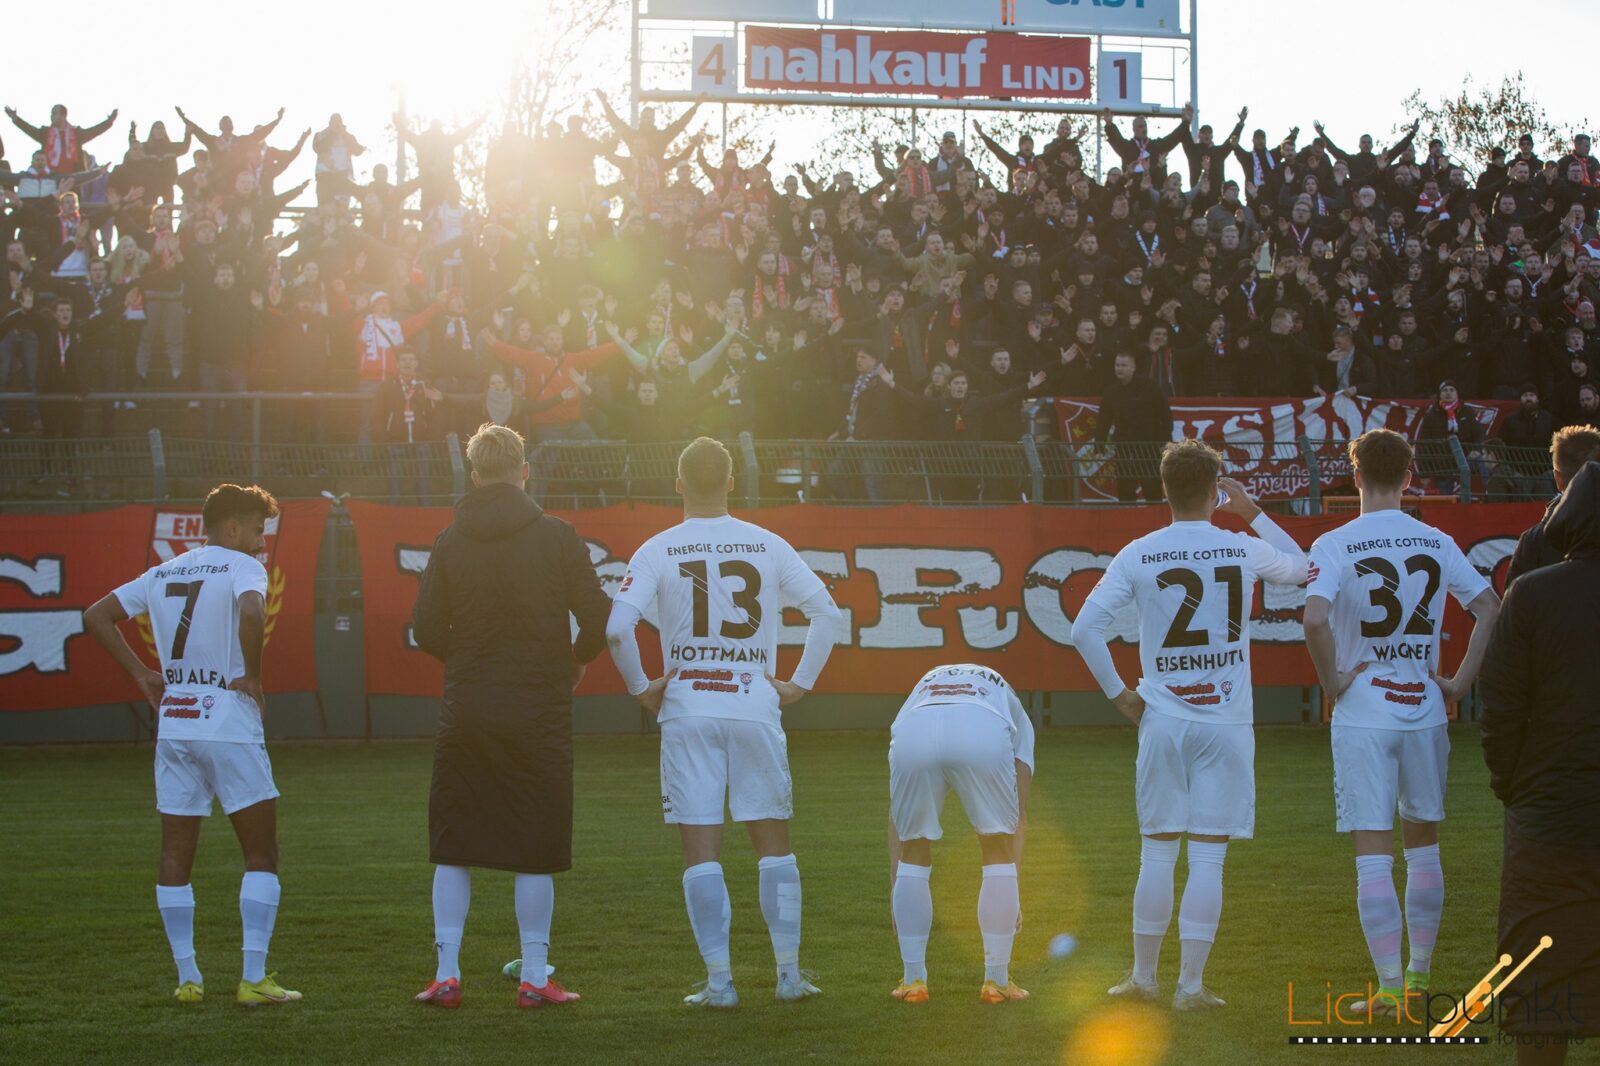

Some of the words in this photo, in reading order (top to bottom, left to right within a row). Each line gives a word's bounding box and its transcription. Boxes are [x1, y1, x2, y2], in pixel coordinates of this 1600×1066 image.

[697, 43, 726, 86] 4
[751, 34, 987, 88] nahkauf
[1002, 64, 1085, 91] LIND
[1113, 58, 1128, 99] 1
[667, 544, 713, 556] ENERGIE
[716, 543, 767, 553] COTTBUS
[1141, 550, 1189, 564] ENERGIE
[1193, 548, 1247, 560] COTTBUS
[1347, 538, 1392, 554] ENERGIE
[1395, 538, 1441, 549] COTTBUS
[188, 564, 229, 575] COTTBUS
[678, 560, 762, 639] 13
[1155, 565, 1243, 648] 21
[1354, 554, 1441, 638] 32
[165, 580, 205, 660] 7
[671, 644, 767, 664] HOTTMANN
[165, 667, 183, 685] BU
